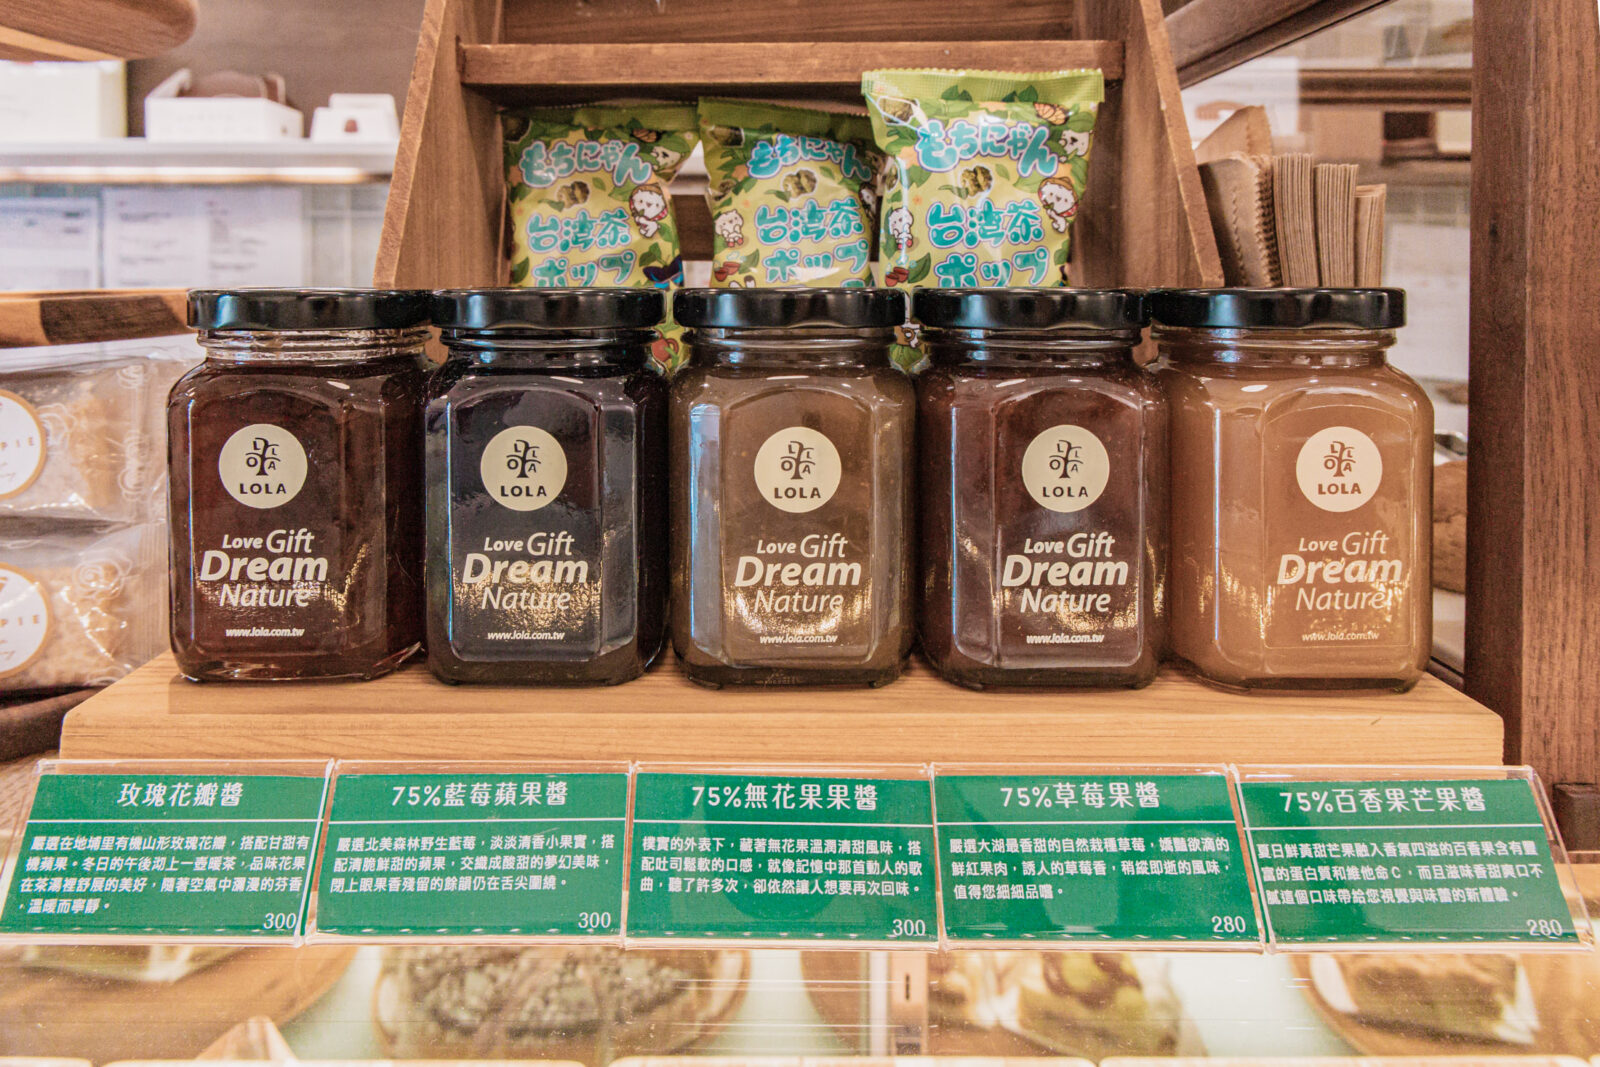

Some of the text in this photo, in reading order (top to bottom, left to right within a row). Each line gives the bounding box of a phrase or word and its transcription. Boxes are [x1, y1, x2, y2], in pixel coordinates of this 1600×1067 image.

[239, 483, 286, 494] LOLA
[501, 485, 547, 497] LOLA
[774, 487, 821, 499] LOLA
[1042, 486, 1088, 498] LOLA
[1317, 483, 1362, 495] LOLA
[222, 528, 314, 553] Love Gift
[483, 530, 575, 556] Love Gift
[756, 532, 848, 558] Love Gift
[1023, 531, 1115, 558] Love Gift
[1298, 530, 1389, 556] Love Gift
[200, 550, 328, 581] Dream
[462, 553, 589, 584] Dream
[734, 555, 861, 587] Dream
[1001, 554, 1129, 587] Dream
[1277, 554, 1402, 585] Dream
[219, 583, 309, 607] Nature
[481, 586, 570, 610] Nature
[753, 589, 844, 613] Nature
[1020, 588, 1111, 613] Nature
[1295, 587, 1386, 611] Nature
[225, 627, 305, 637] www.lola.com.tw
[487, 630, 565, 640] www.lola.com.tw
[759, 633, 838, 644] www.lola.com.tw
[1026, 632, 1105, 644] www.lola.com.tw
[1302, 631, 1380, 641] www.lola.com.tw
[117, 782, 243, 806] 玫瑰花瓣醬
[393, 781, 567, 806] 75%藍莓蘋果醬
[693, 783, 877, 810] 75%無花果果醬
[1001, 782, 1159, 808] 75%草莓果醬
[1280, 787, 1485, 812] 75%百香果芒果醬
[264, 913, 297, 933] 300
[579, 912, 611, 931] 300
[891, 919, 926, 938] 300
[1212, 916, 1245, 932] 280
[1527, 919, 1562, 937] 280
